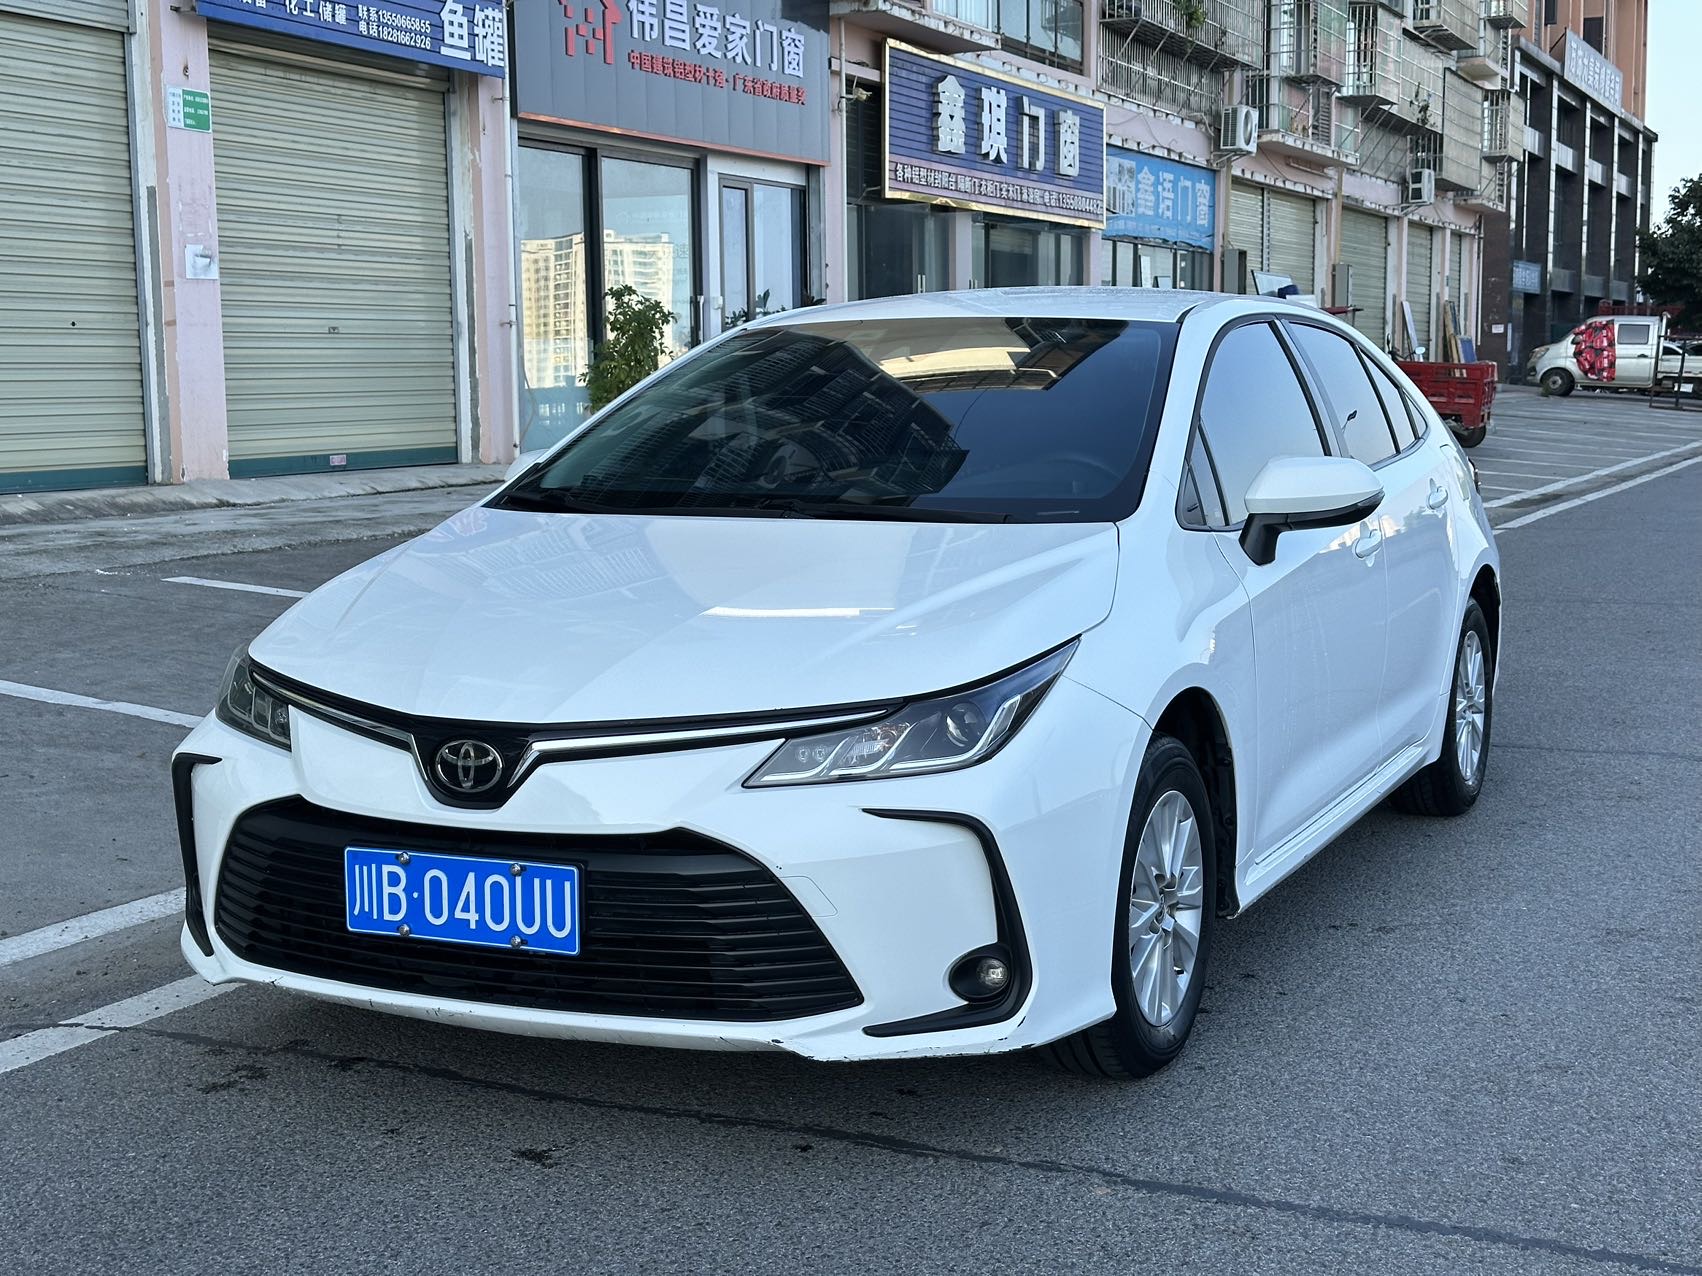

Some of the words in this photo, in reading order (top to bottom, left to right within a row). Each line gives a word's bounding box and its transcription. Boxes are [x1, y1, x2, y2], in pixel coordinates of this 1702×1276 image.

[439, 0, 505, 67] 鱼罐
[627, 0, 805, 78] 伟昌爱家门窗
[934, 74, 1080, 178] 鑫琪门窗
